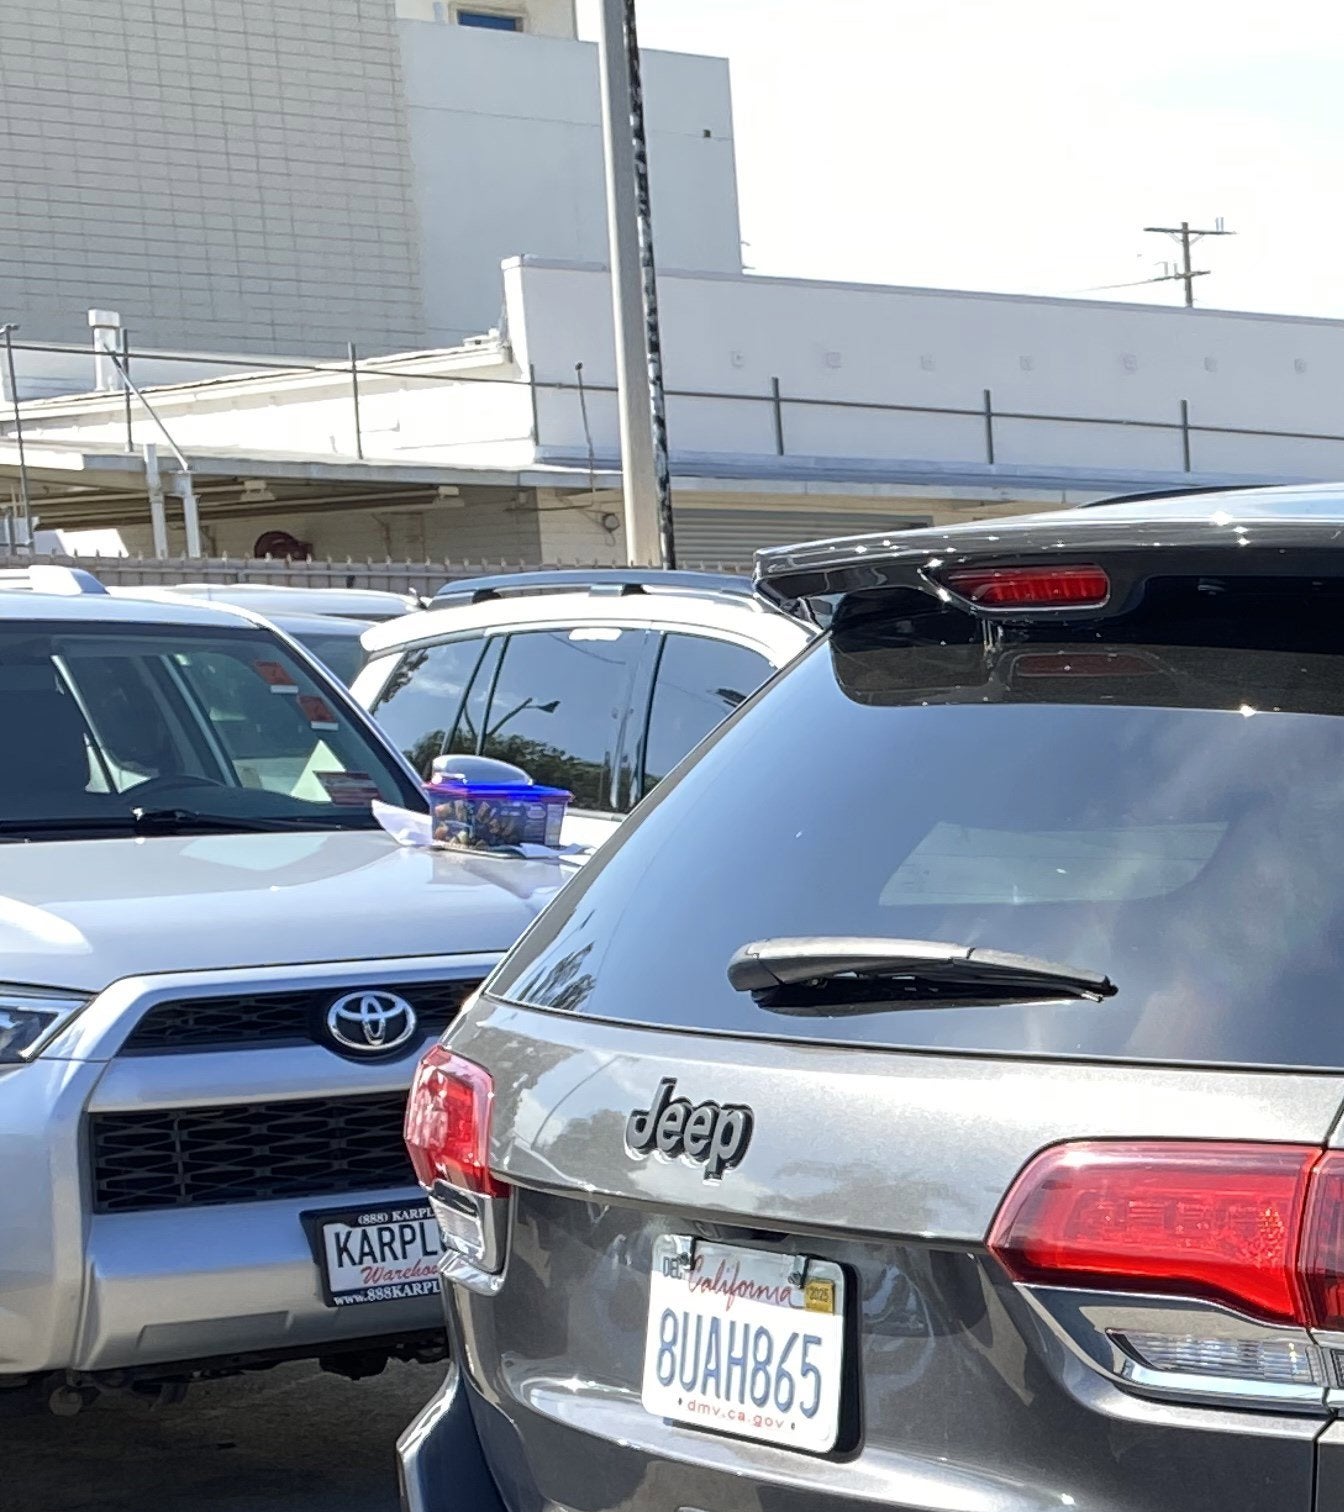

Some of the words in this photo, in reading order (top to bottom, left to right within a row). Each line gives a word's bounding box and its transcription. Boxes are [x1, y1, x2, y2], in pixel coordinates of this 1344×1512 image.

[625, 1076, 755, 1181] Jeep
[392, 1207, 435, 1221] KARPL
[334, 1221, 446, 1268] KARPL
[333, 1280, 440, 1305] www.888KARPL
[688, 1254, 792, 1312] California
[656, 1307, 822, 1419] 8UAH865
[687, 1399, 784, 1428] dmv.ca.gov
